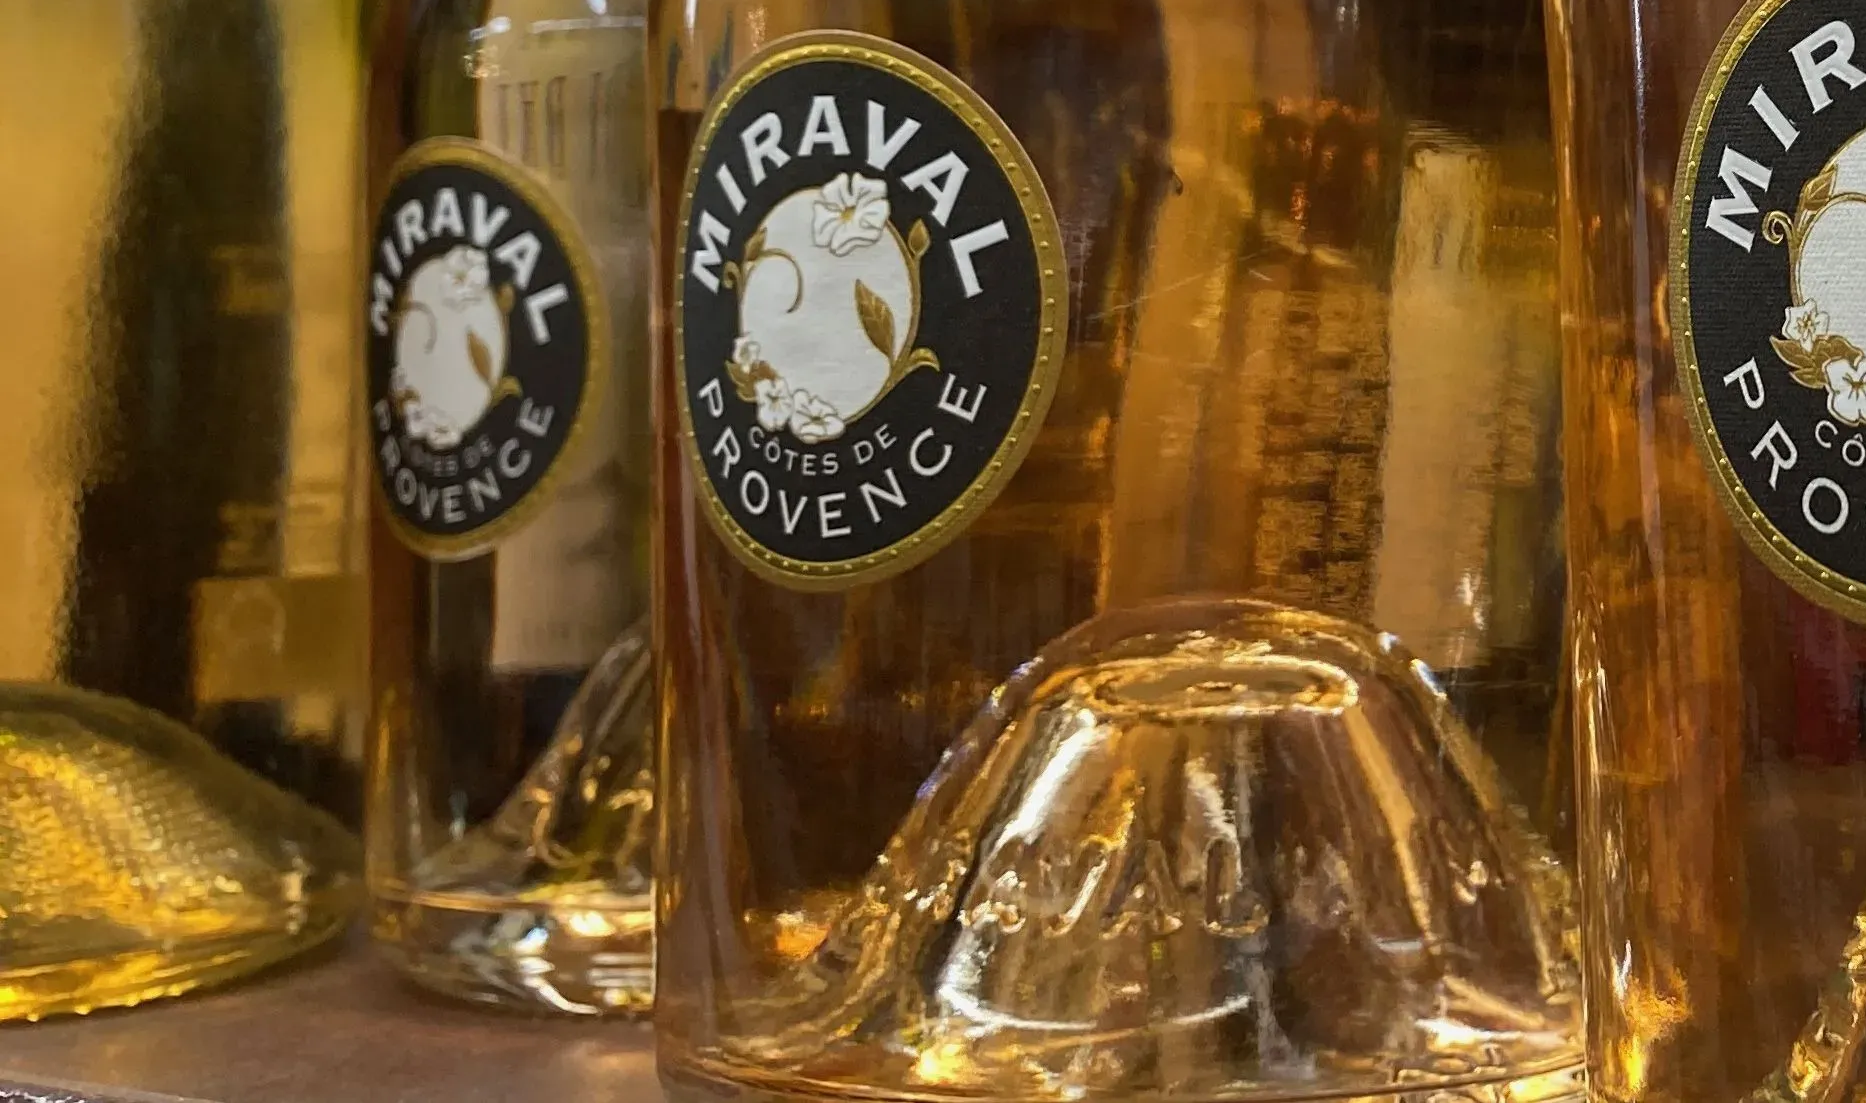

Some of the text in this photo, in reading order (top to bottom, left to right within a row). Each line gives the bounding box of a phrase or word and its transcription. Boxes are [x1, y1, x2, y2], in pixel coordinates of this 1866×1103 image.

[371, 188, 568, 344] MIRAVAL
[692, 96, 1010, 297] MIRAVAL
[698, 374, 986, 537] PROVENCE
[749, 424, 897, 476] CÔTES DE
